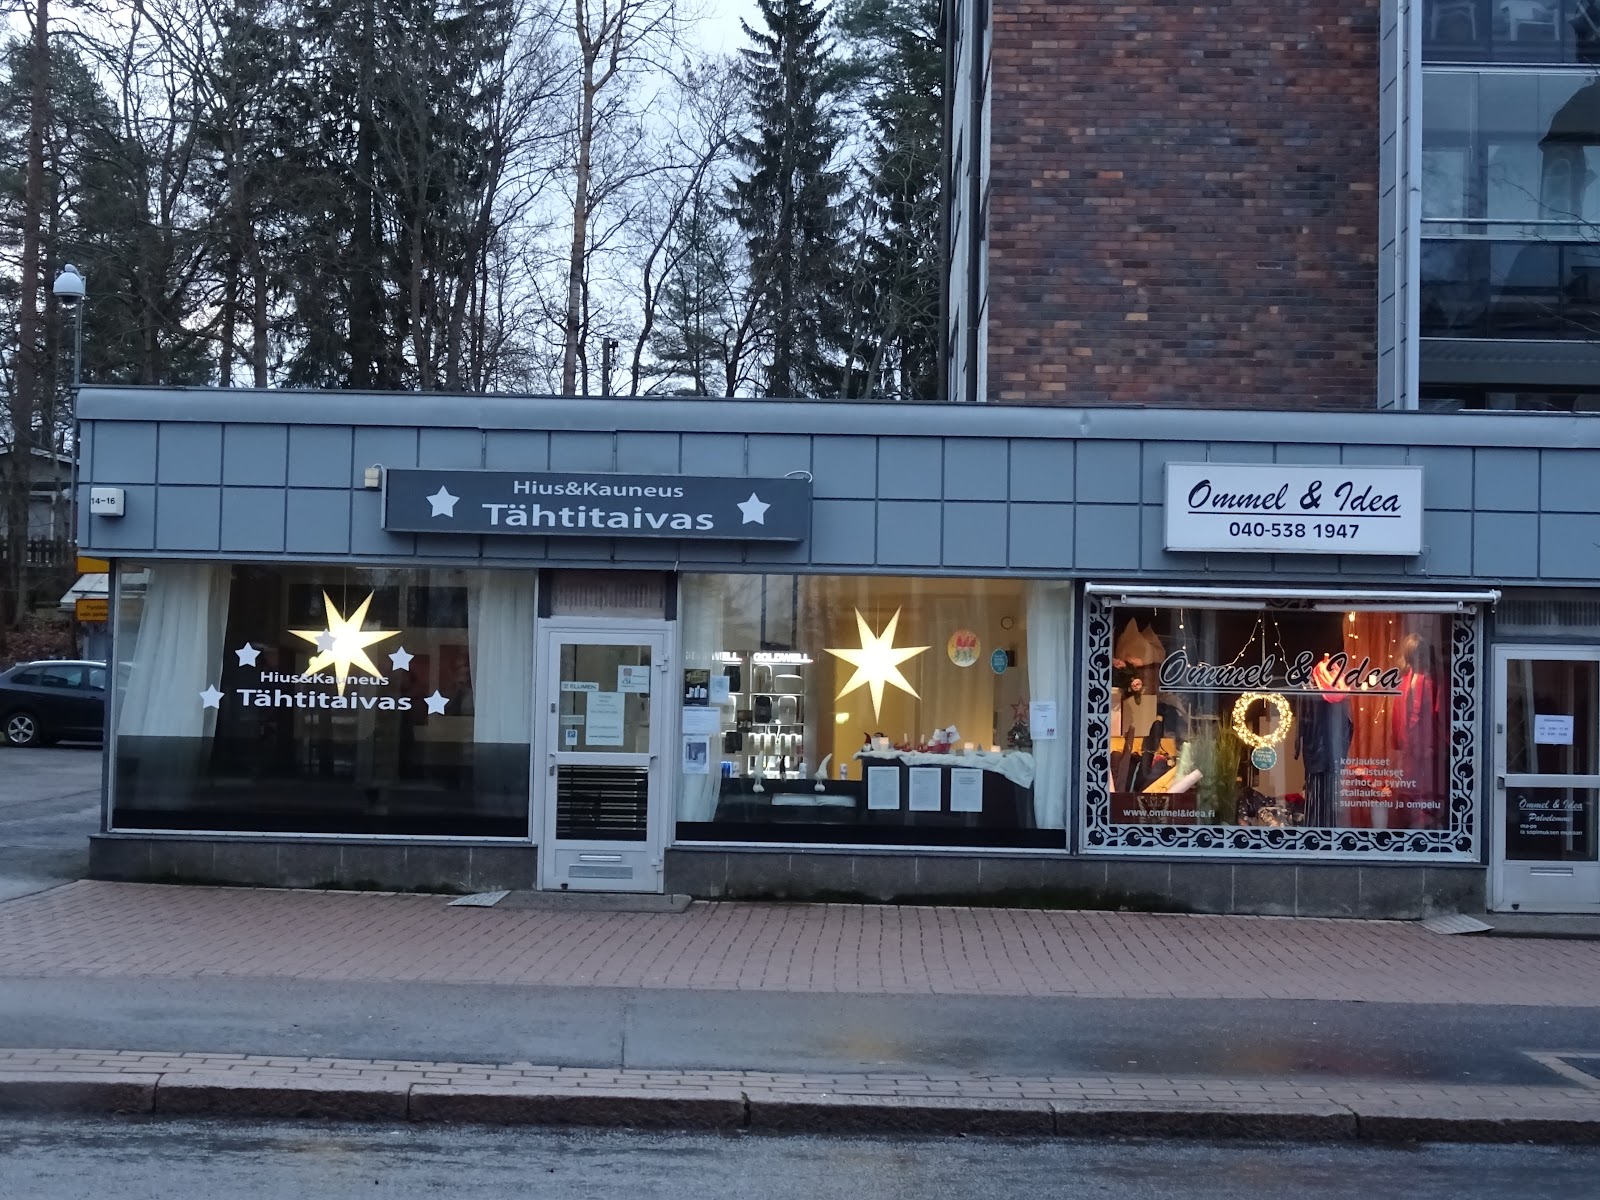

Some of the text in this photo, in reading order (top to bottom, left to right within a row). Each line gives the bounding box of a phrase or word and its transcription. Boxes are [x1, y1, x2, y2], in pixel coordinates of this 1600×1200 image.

[513, 480, 684, 498] Hius&Kauneus
[1187, 479, 1402, 512] Ommel & Idea
[482, 503, 714, 530] Tähtitaivas
[1229, 521, 1360, 539] 040-538 1947
[1159, 650, 1276, 688] Ommel
[1285, 651, 1314, 687] &
[260, 671, 390, 686] Hius&Kauneus
[236, 689, 412, 710] Tähtitaivas
[1340, 757, 1390, 767] korjaukset
[1340, 778, 1371, 787] verhot
[1384, 779, 1417, 789] tyynyt
[1123, 809, 1216, 818] www.ommel&idea.fi
[1340, 800, 1440, 810] suunnittelu ja ompelu
